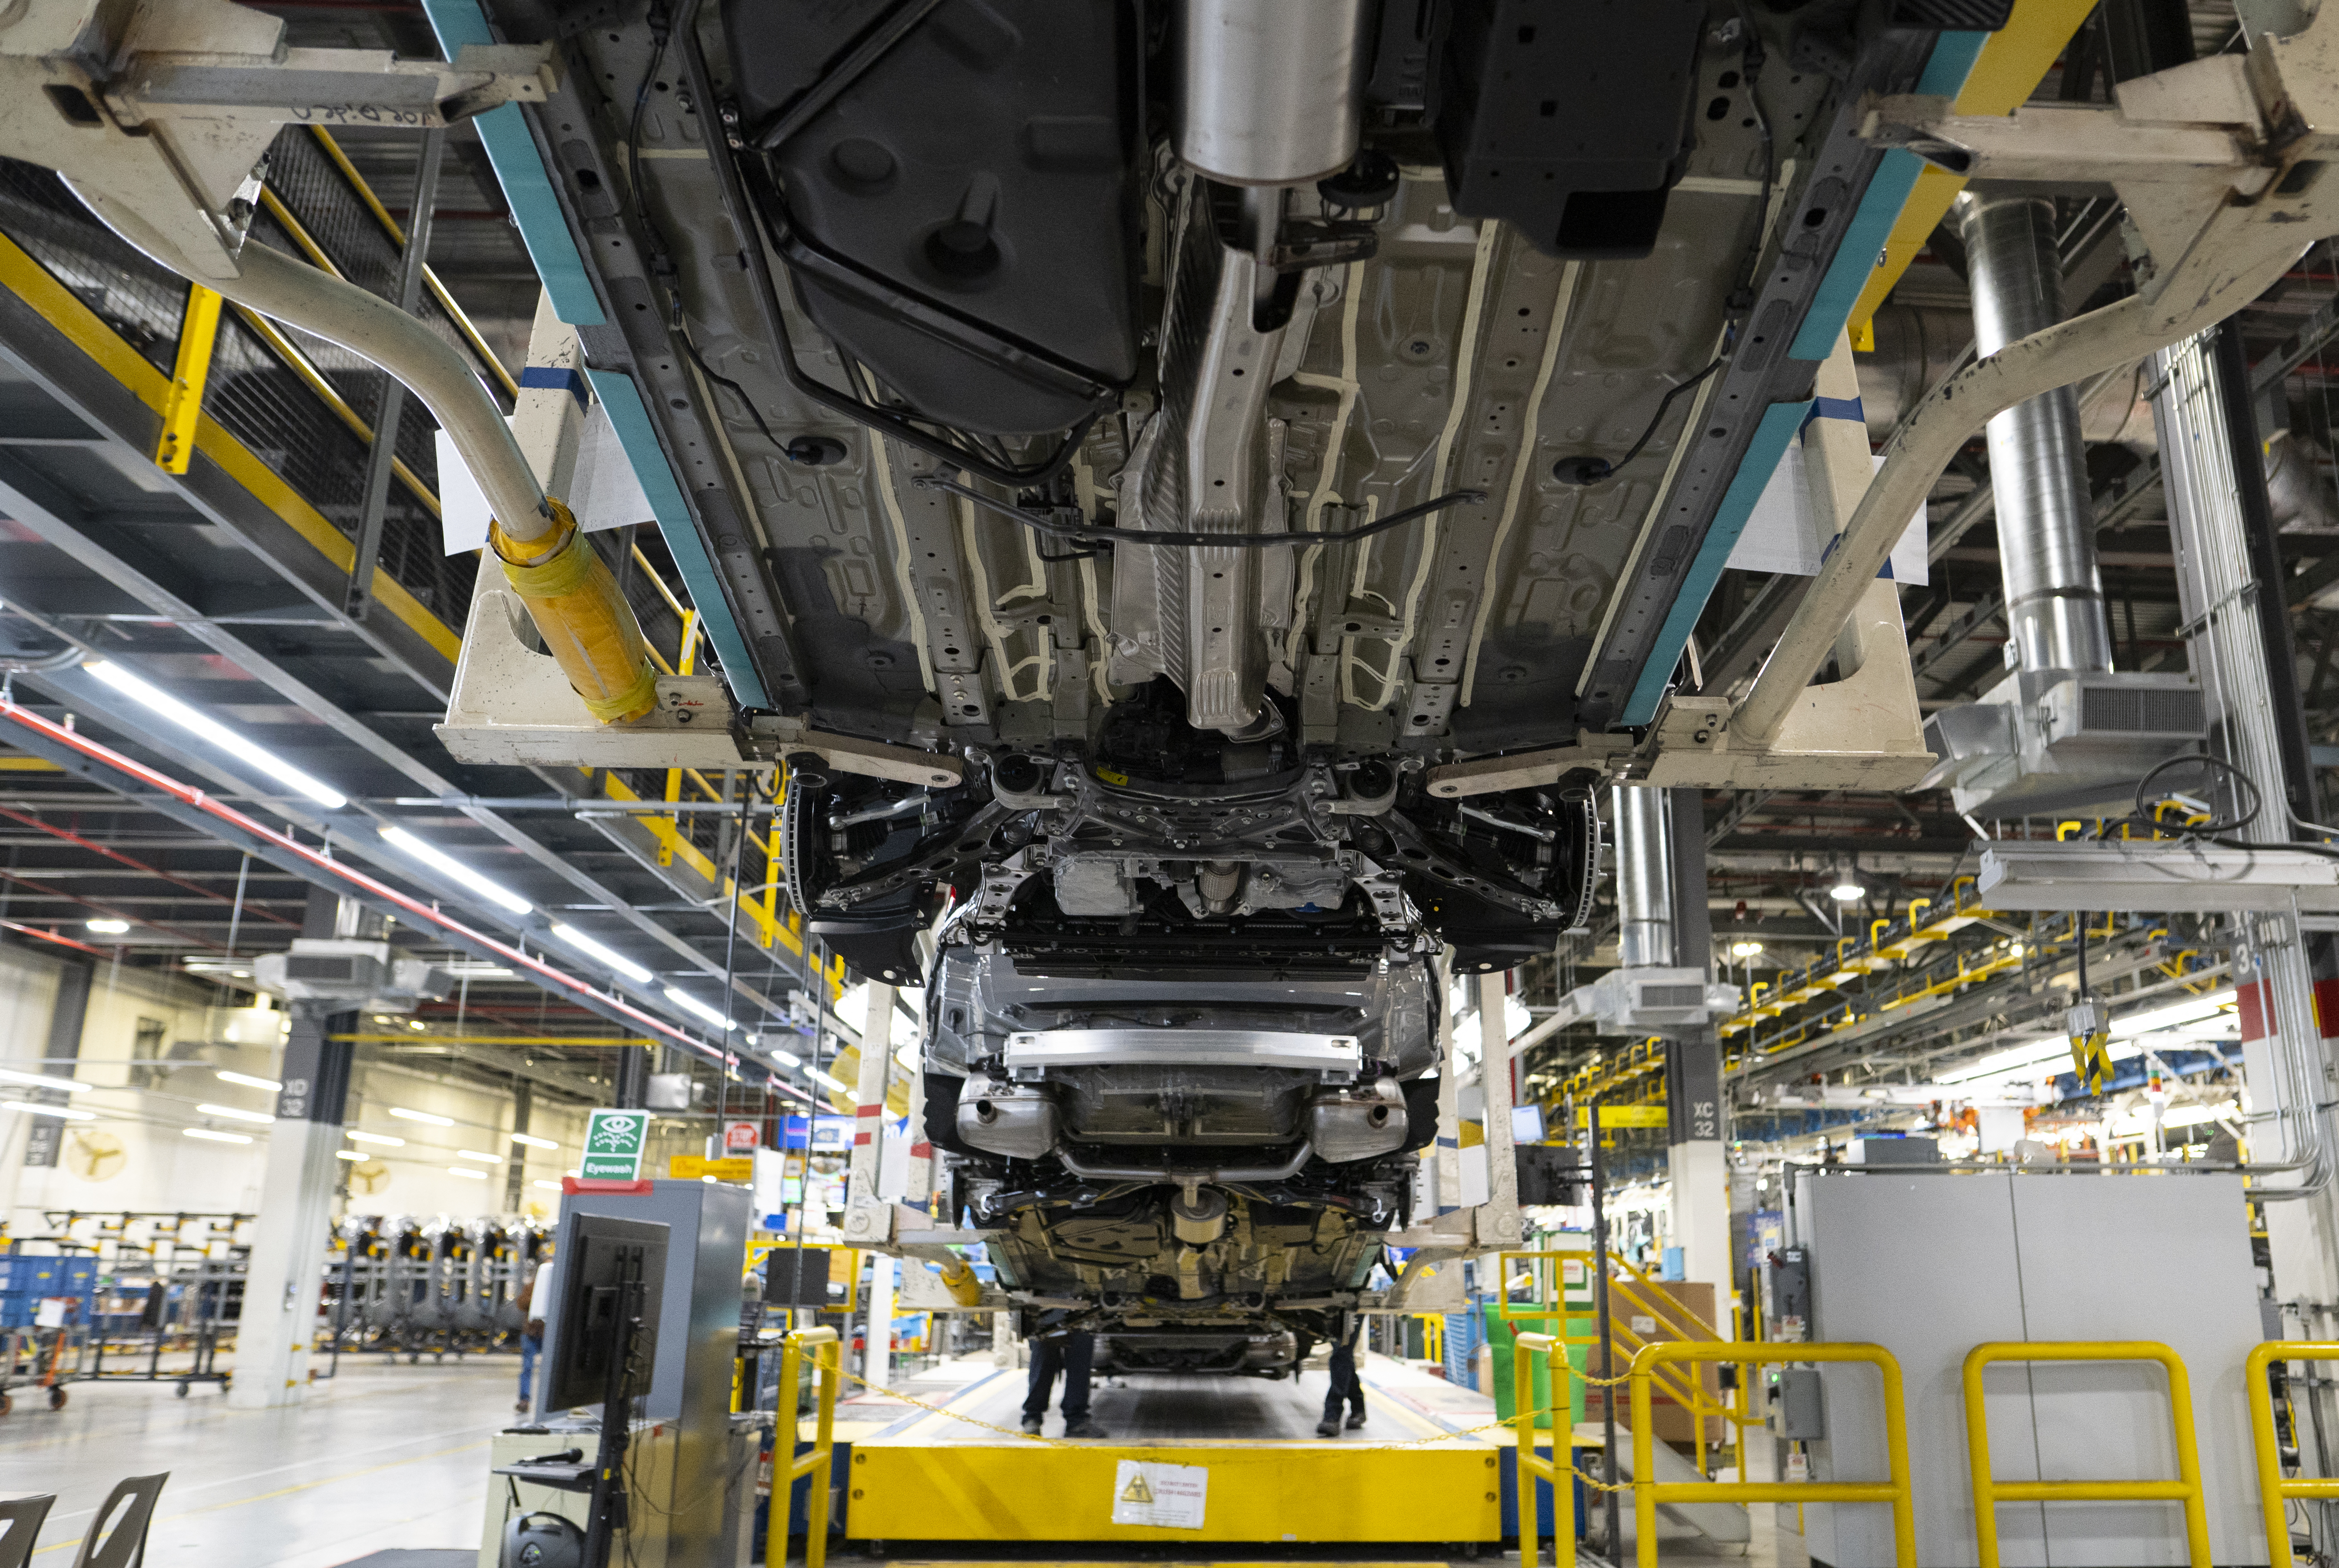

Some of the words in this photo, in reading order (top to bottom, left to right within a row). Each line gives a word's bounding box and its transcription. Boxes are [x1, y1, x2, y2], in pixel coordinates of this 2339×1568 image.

[1693, 1101, 1714, 1118] XC
[1695, 1121, 1715, 1137] 32
[586, 1162, 633, 1175] Eyewash
